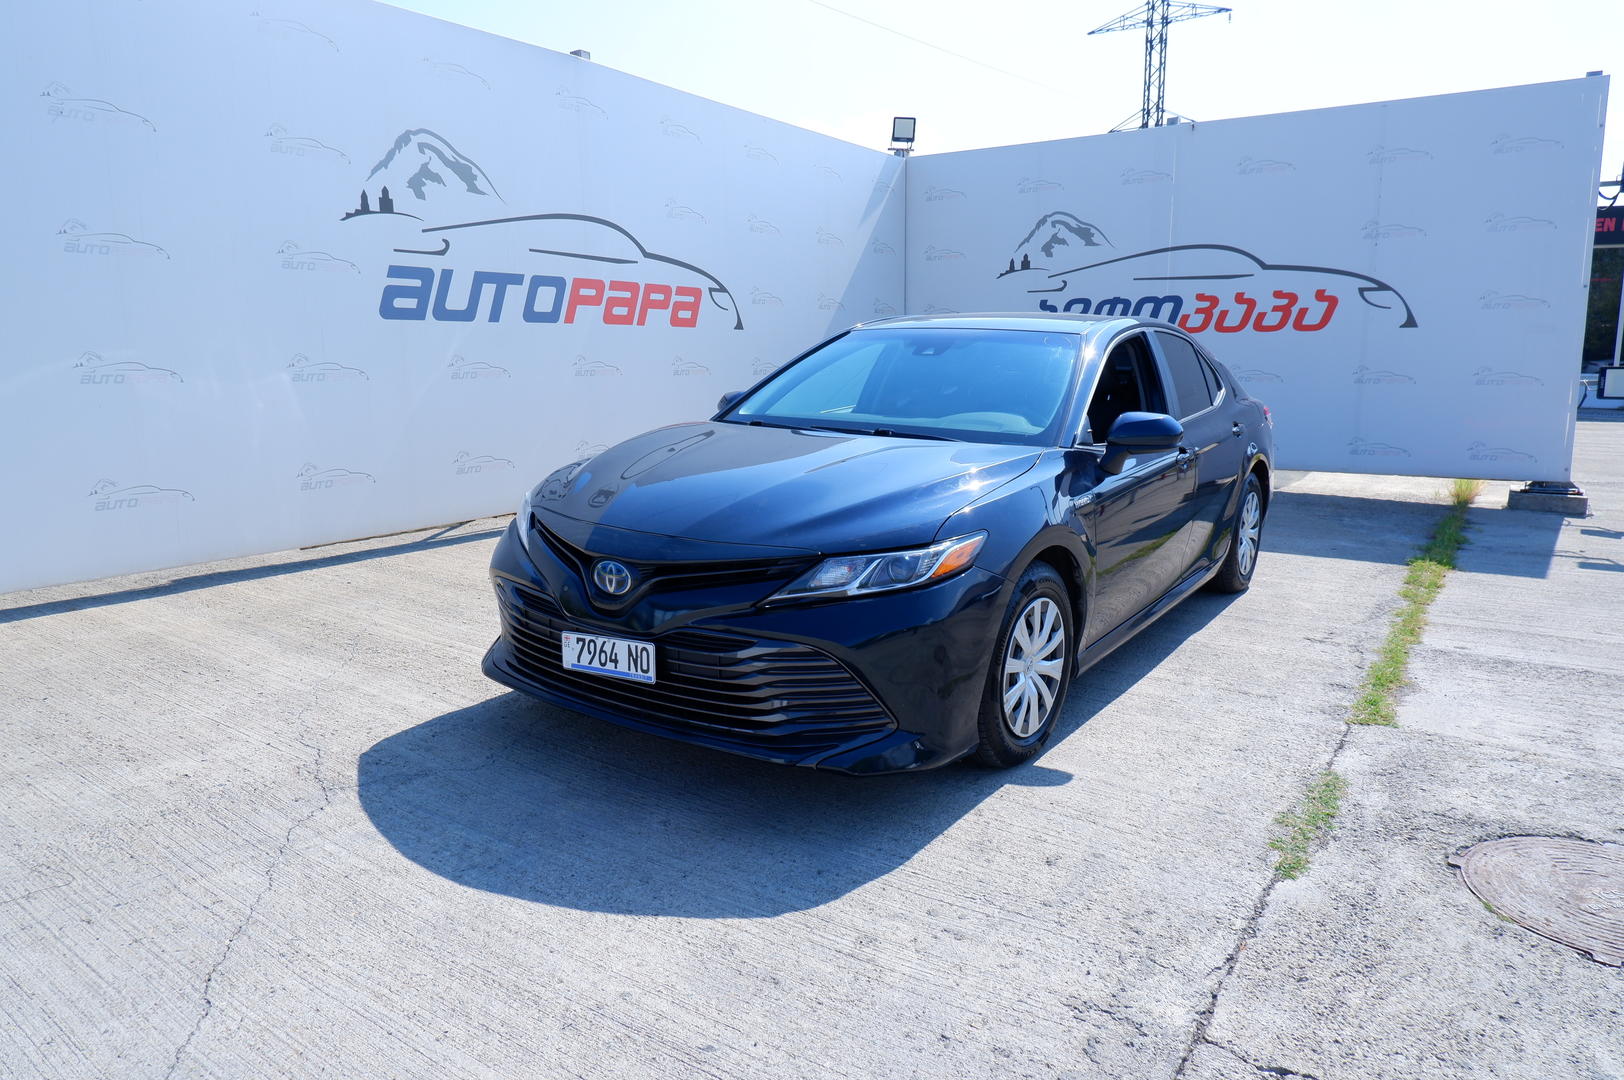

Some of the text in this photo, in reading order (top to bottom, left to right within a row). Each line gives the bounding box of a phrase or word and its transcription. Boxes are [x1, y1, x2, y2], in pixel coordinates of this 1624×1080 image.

[1038, 289, 1339, 335] ოპაპა
[575, 637, 650, 674] 7964 NO
